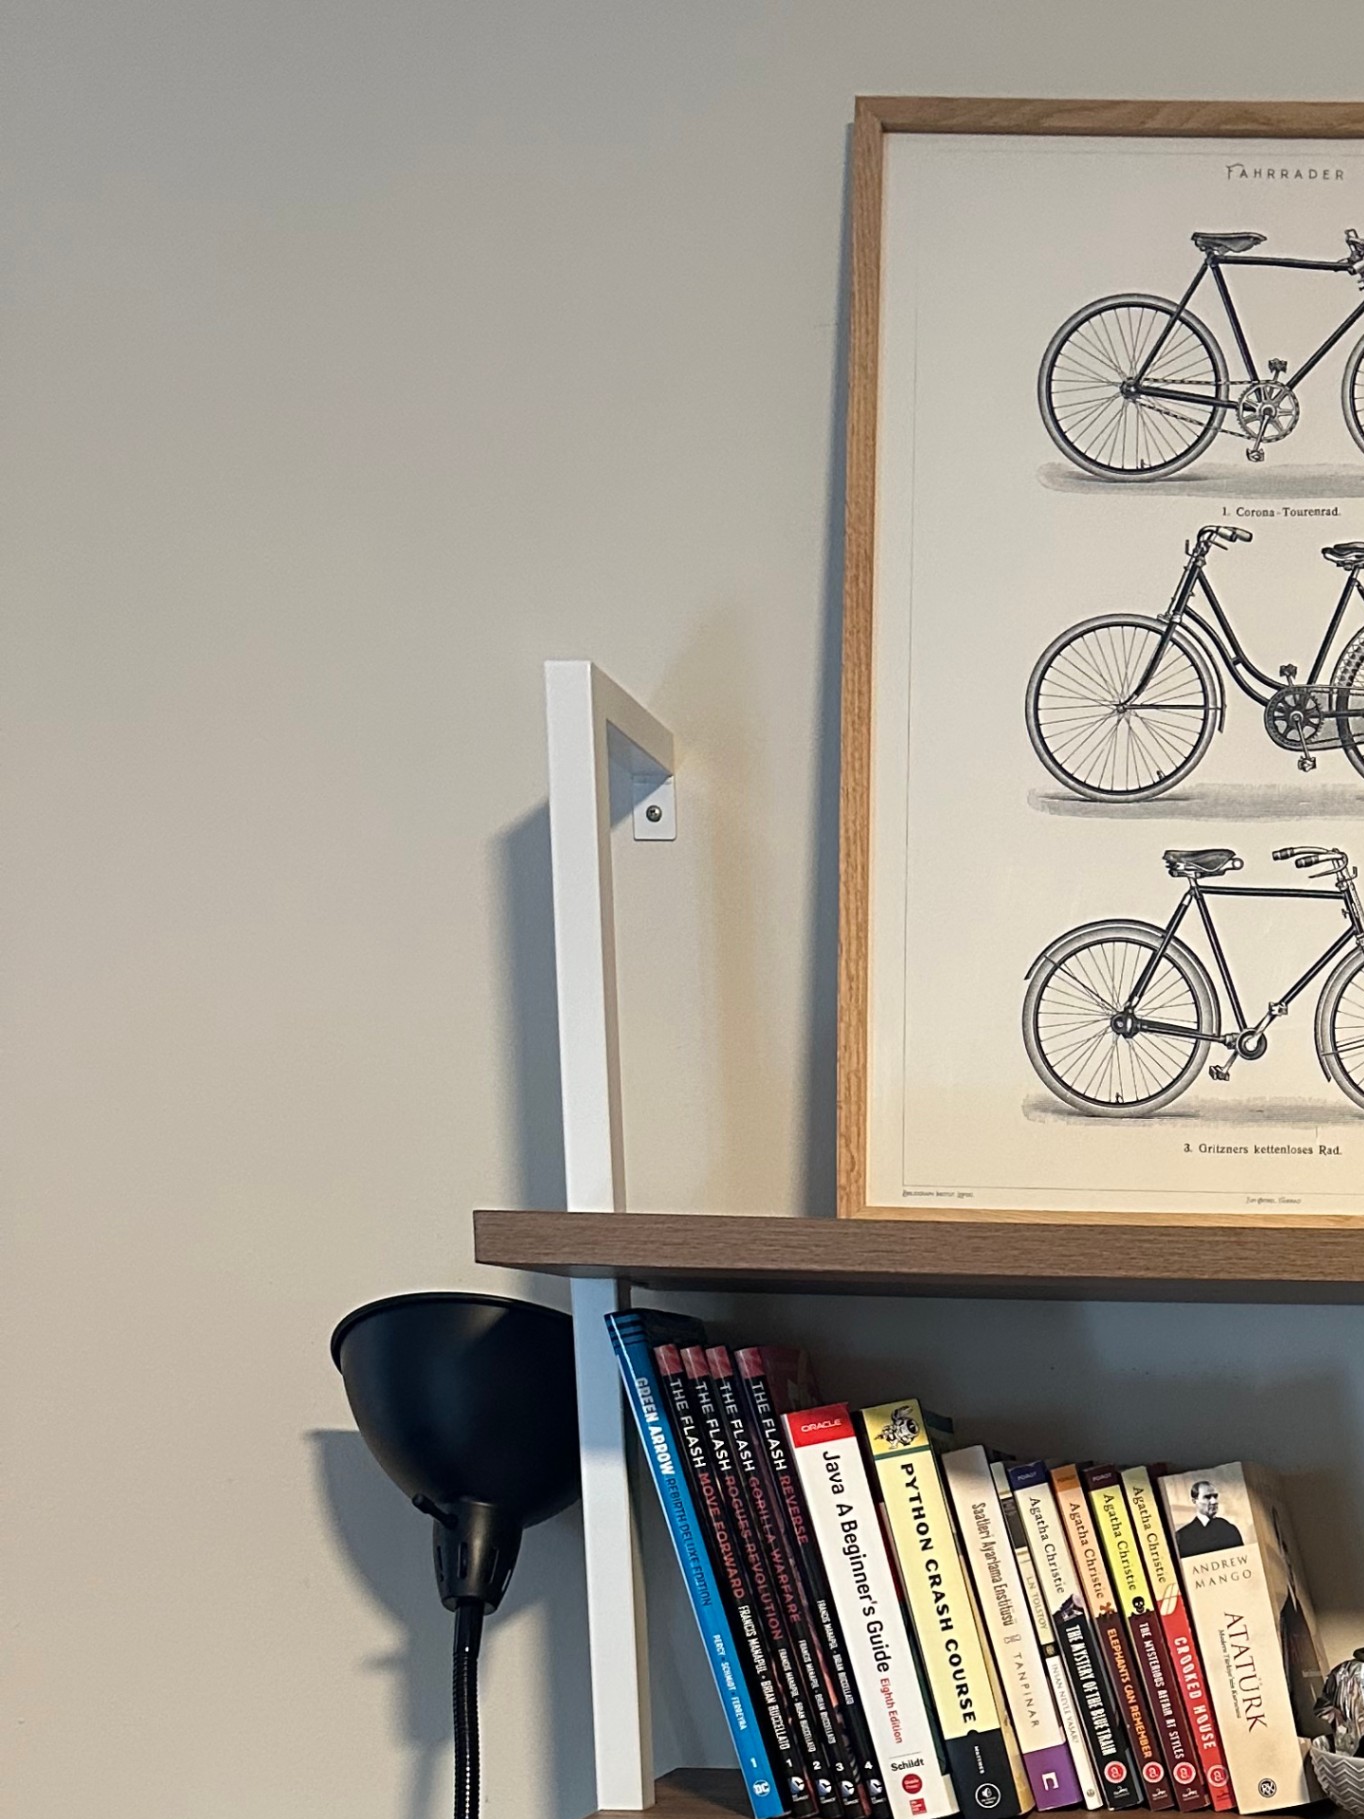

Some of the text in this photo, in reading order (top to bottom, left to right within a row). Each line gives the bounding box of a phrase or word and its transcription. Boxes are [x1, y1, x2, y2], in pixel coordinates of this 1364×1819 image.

[1183, 1143, 1343, 1156] 3. Gritzners kettenloses Rad.
[637, 1377, 676, 1475] GREEN ARROW
[752, 1381, 808, 1545] THE FLASH REVERSE
[801, 1419, 842, 1432] ORACLE
[667, 1477, 688, 1522] REBIRTH
[670, 1378, 745, 1599] THE FLASH MOVE FORWARD
[696, 1381, 783, 1641] THE FLASH ROGUES REVOLUTION
[720, 1382, 801, 1623] THE FLASH GORILLA WARFARE
[972, 1502, 994, 1539] Saatleri
[1133, 1487, 1166, 1583] Agatha Christie
[822, 1451, 892, 1673] Java A Beginner's Guide
[979, 1541, 1003, 1585] Ayarlama
[1029, 1497, 1065, 1594] Agatha Christie
[1069, 1503, 1105, 1599] Agatha Christie
[1103, 1494, 1137, 1591] Agatha Christie
[1192, 1555, 1249, 1575] ANDREW
[1195, 1569, 1252, 1590] MANGO
[900, 1463, 977, 1723] PYTHON CRASH COURSE
[1031, 1593, 1048, 1630] TOLSTOY
[713, 1634, 726, 1656] PERCY
[738, 1604, 791, 1750] FRANCIS MANAPUL BRIAN BUCCELLATO
[1066, 1624, 1117, 1757] THE MYSTERY OF THE BLUE TRAIN
[1139, 1622, 1185, 1760] THE MYSTERIOUS AFFAIR AT STYLES
[1174, 1636, 1217, 1750] CROOKED HOUSE
[1224, 1612, 1268, 1733] ATATÜRK
[879, 1677, 903, 1744] Eighth Edition
[1107, 1628, 1153, 1759] ELEPHANTS CAN REMEMBER
[750, 1758, 757, 1768] 1
[786, 1759, 793, 1768] 1
[812, 1760, 822, 1770] 2
[835, 1762, 845, 1772] 3
[864, 1760, 873, 1770] 4
[890, 1758, 925, 1772] Schildt
